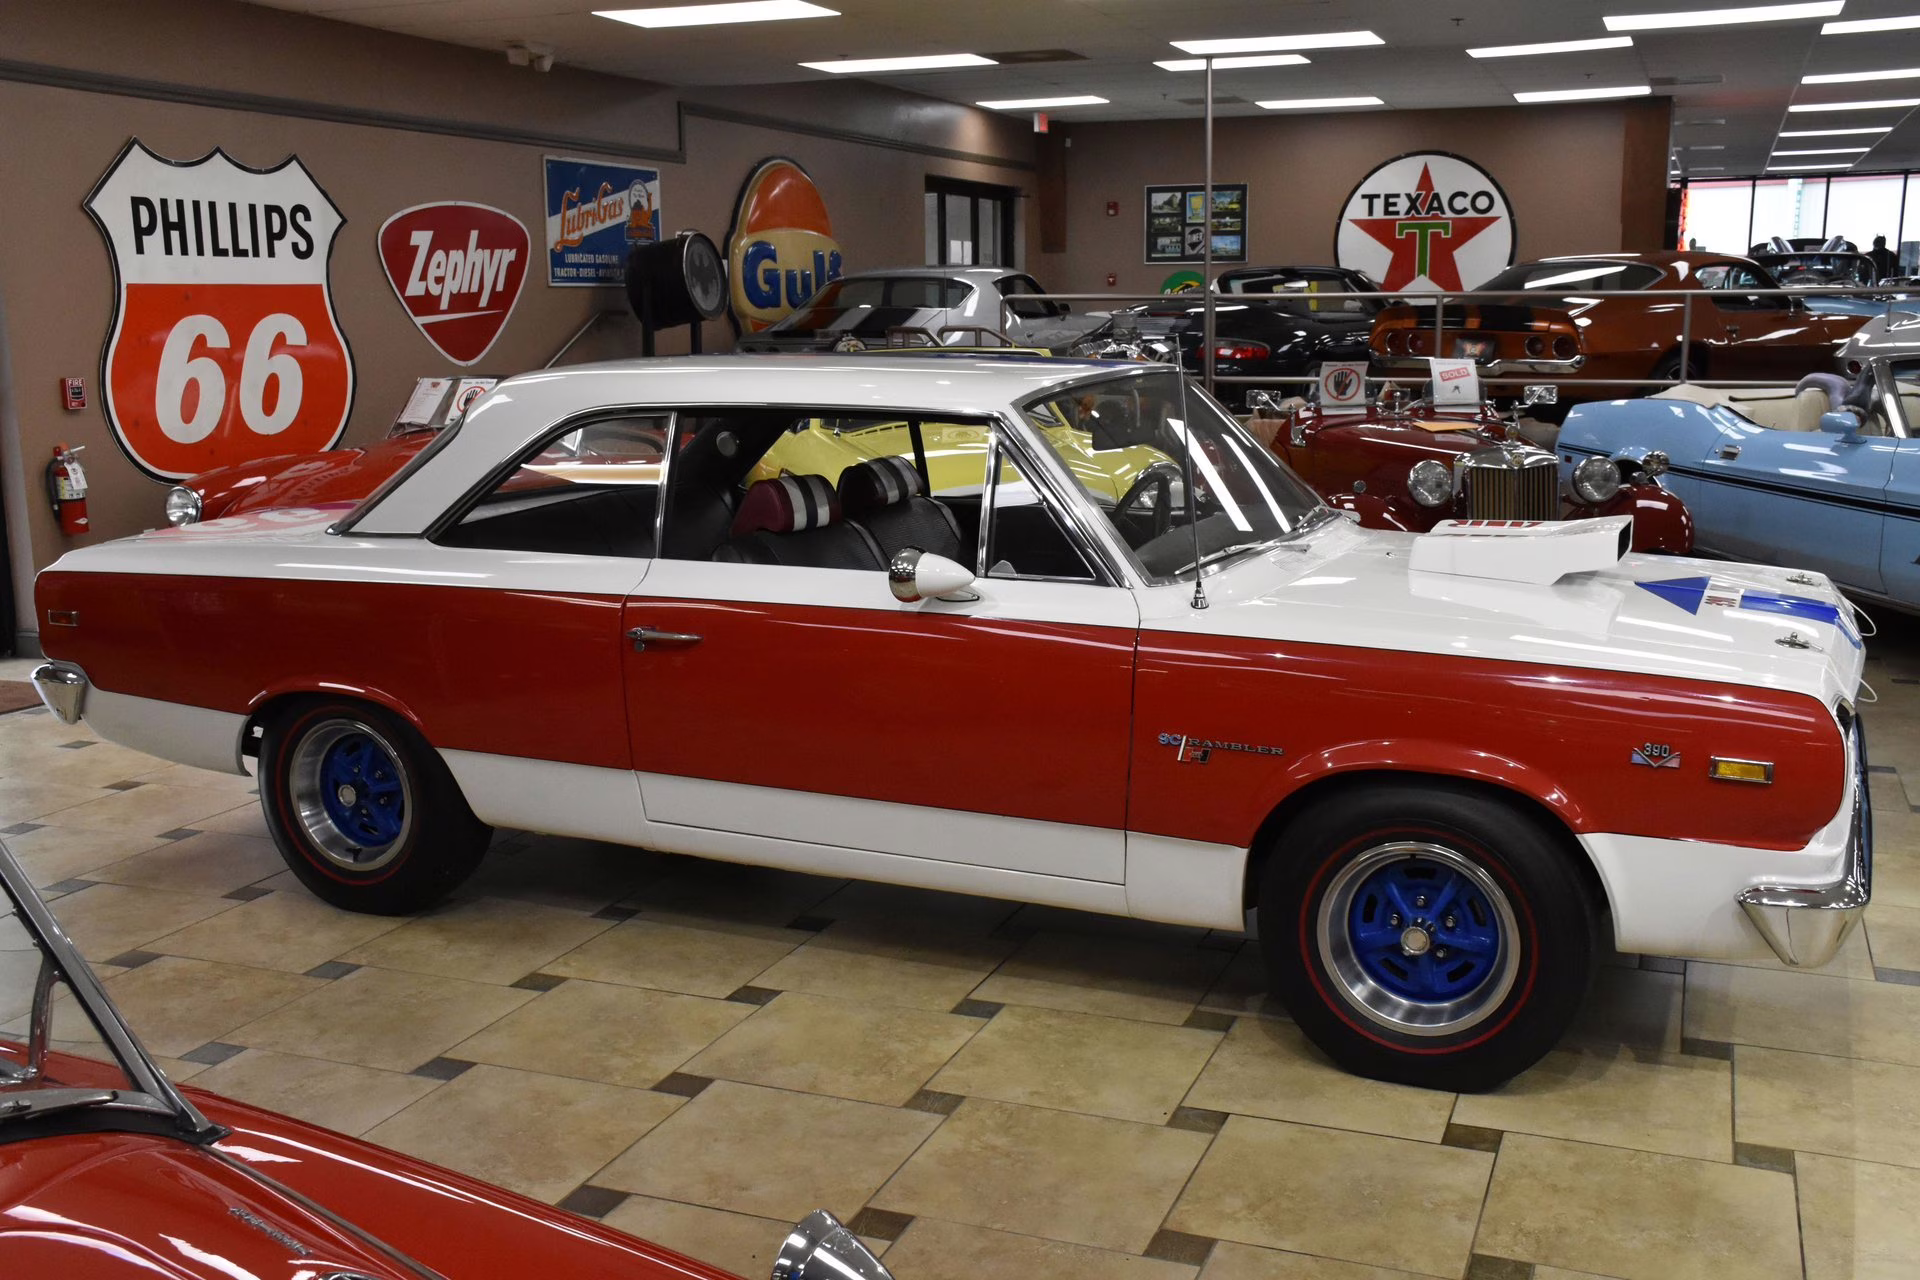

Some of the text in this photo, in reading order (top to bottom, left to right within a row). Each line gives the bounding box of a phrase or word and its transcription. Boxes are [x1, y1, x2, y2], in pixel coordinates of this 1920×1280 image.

[130, 196, 315, 260] PHILLIPS
[1361, 190, 1495, 217] TEXACO
[404, 229, 518, 310] Zephyr
[1395, 221, 1452, 279] T
[155, 312, 309, 444] 66
[1441, 369, 1468, 380] SOLD
[1644, 742, 1670, 757] 390
